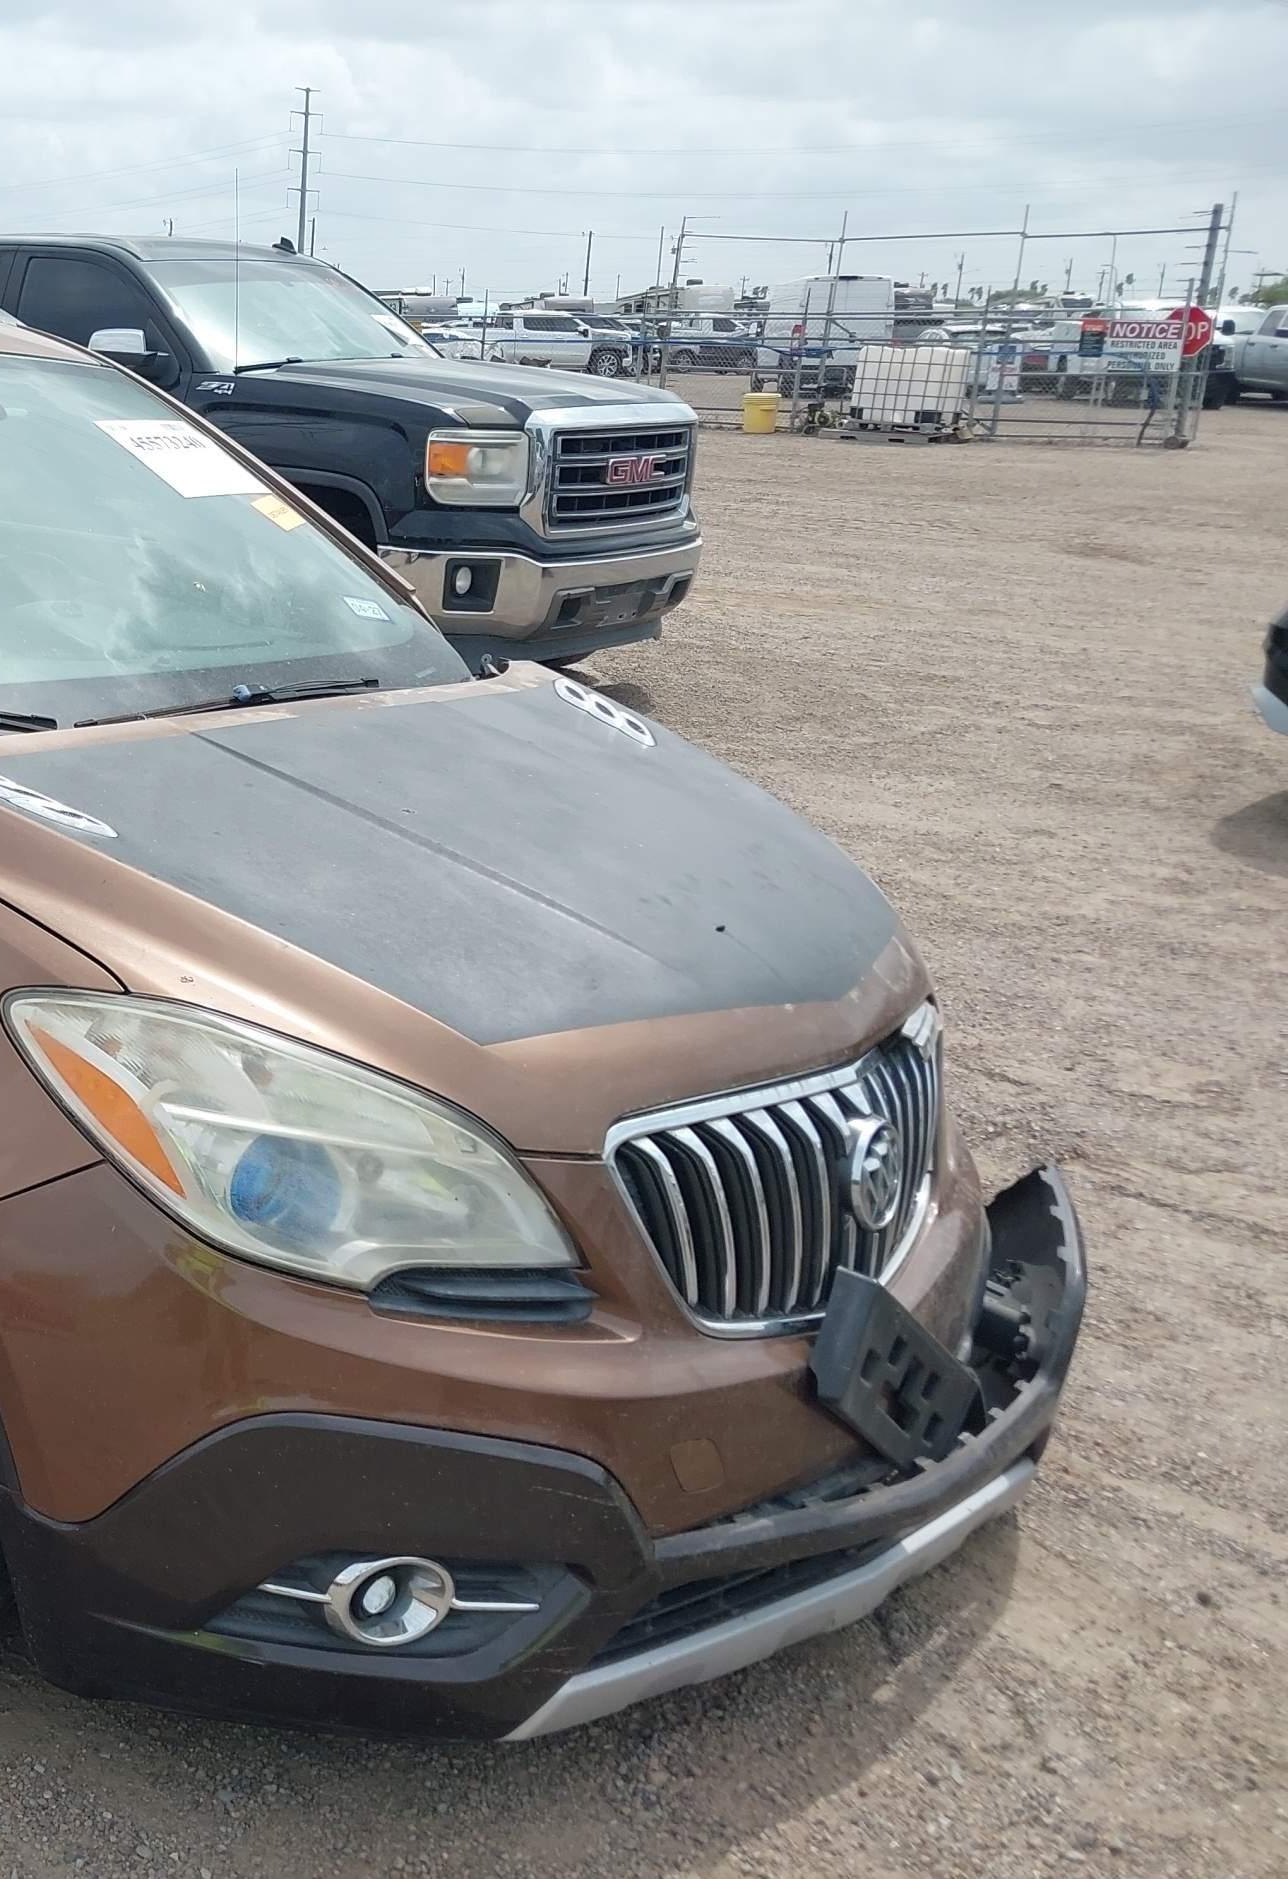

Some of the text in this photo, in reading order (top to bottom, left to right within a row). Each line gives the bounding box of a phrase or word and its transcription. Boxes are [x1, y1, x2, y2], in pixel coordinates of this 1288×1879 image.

[1112, 323, 1180, 338] NOTICE
[1186, 322, 1209, 340] OP
[1111, 340, 1156, 350] RESTRICTED
[1158, 341, 1178, 350] AREA
[1154, 361, 1175, 371] ONLY
[606, 455, 666, 484] GMC
